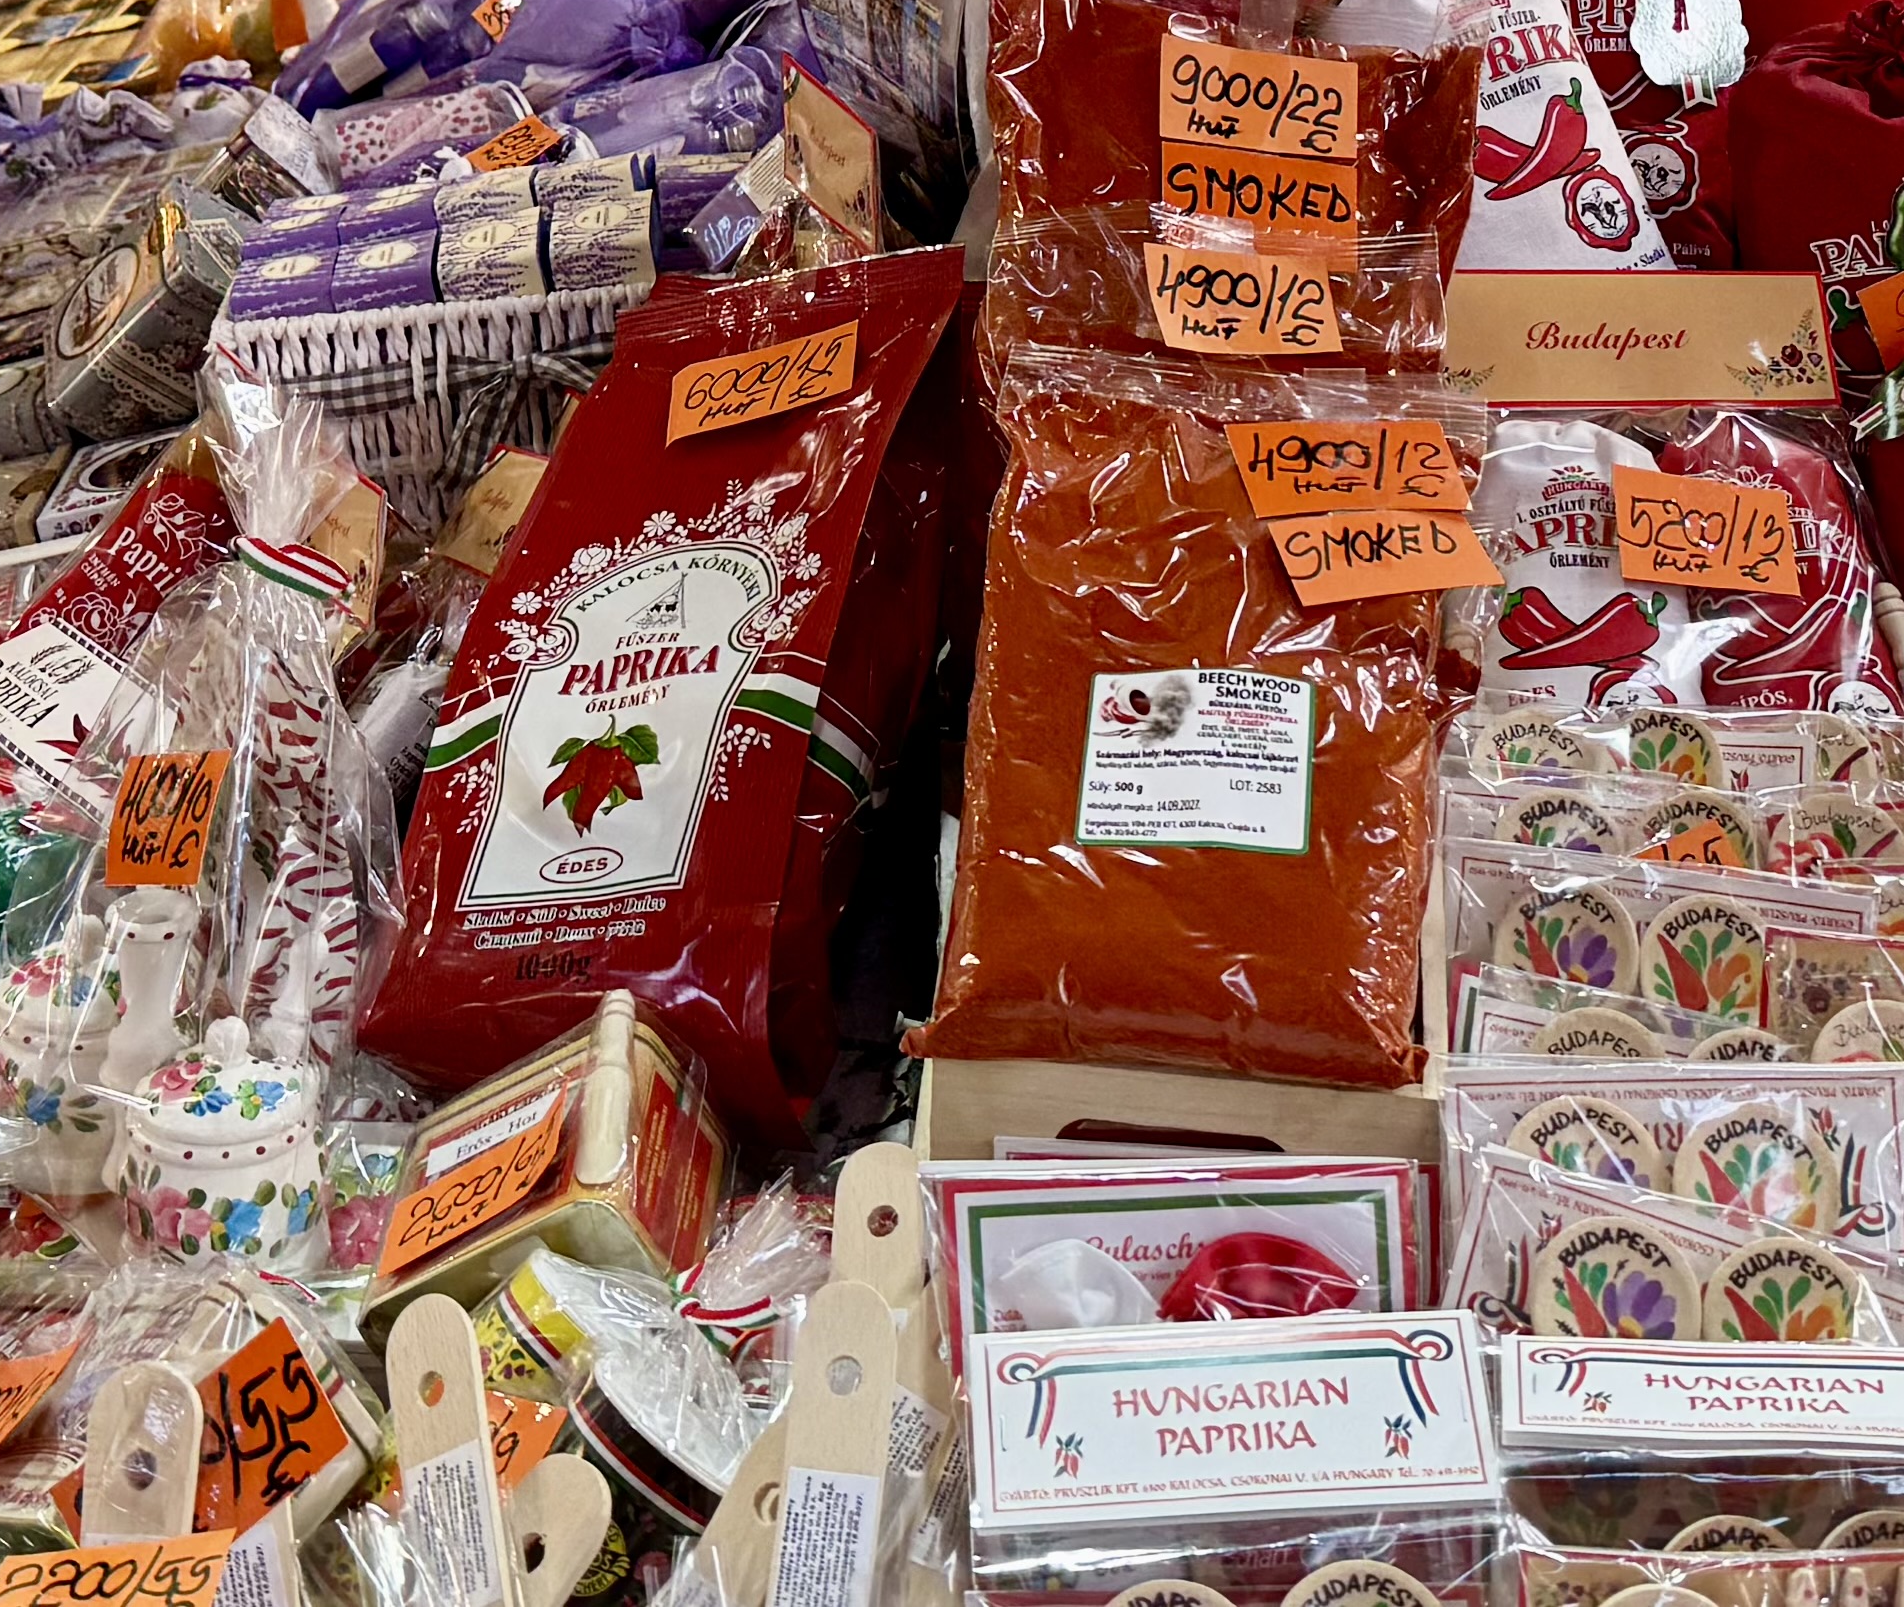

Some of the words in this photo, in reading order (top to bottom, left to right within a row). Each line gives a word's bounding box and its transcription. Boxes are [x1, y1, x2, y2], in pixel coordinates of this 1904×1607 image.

[1170, 52, 1342, 137] 9000/22
[1480, 74, 1543, 112] ŐRLEMÉNY
[1166, 162, 1352, 223] SMOKED
[1156, 254, 1325, 331] 4900/12
[1525, 320, 1689, 360] Budapest
[1247, 428, 1450, 492] 4900/12
[1284, 520, 1458, 581] SMOKED
[1625, 494, 1787, 569] 5200/13
[575, 560, 680, 613] KALOCSA
[615, 631, 681, 650] FŰSZER
[558, 645, 720, 697] PAPRIKA
[1198, 672, 1248, 687] BEECH
[1251, 675, 1302, 695] WOOD
[1215, 686, 1282, 704] SMOKED
[1490, 722, 1583, 759] BUDAPEST
[1114, 782, 1134, 793] 500
[1229, 778, 1254, 793] LOT:
[1255, 782, 1282, 795] 2583
[1518, 798, 1614, 841] BUDAPEST
[555, 852, 608, 875] ÉDES
[1662, 899, 1762, 946] BUDAPEST
[507, 1110, 539, 1133] Hot
[1528, 1108, 1640, 1150] BUDAPEST
[1703, 1114, 1814, 1164] BUDAPEST
[1558, 1228, 1674, 1272] BUDAPEST
[1725, 1249, 1844, 1294] BUDAPEST
[1111, 1375, 1350, 1419] HUNGARIAN
[1643, 1371, 1885, 1395] HUNGARIAN
[1687, 1395, 1852, 1416] PAPRIKA
[1154, 1419, 1318, 1459] PAPRIKA
